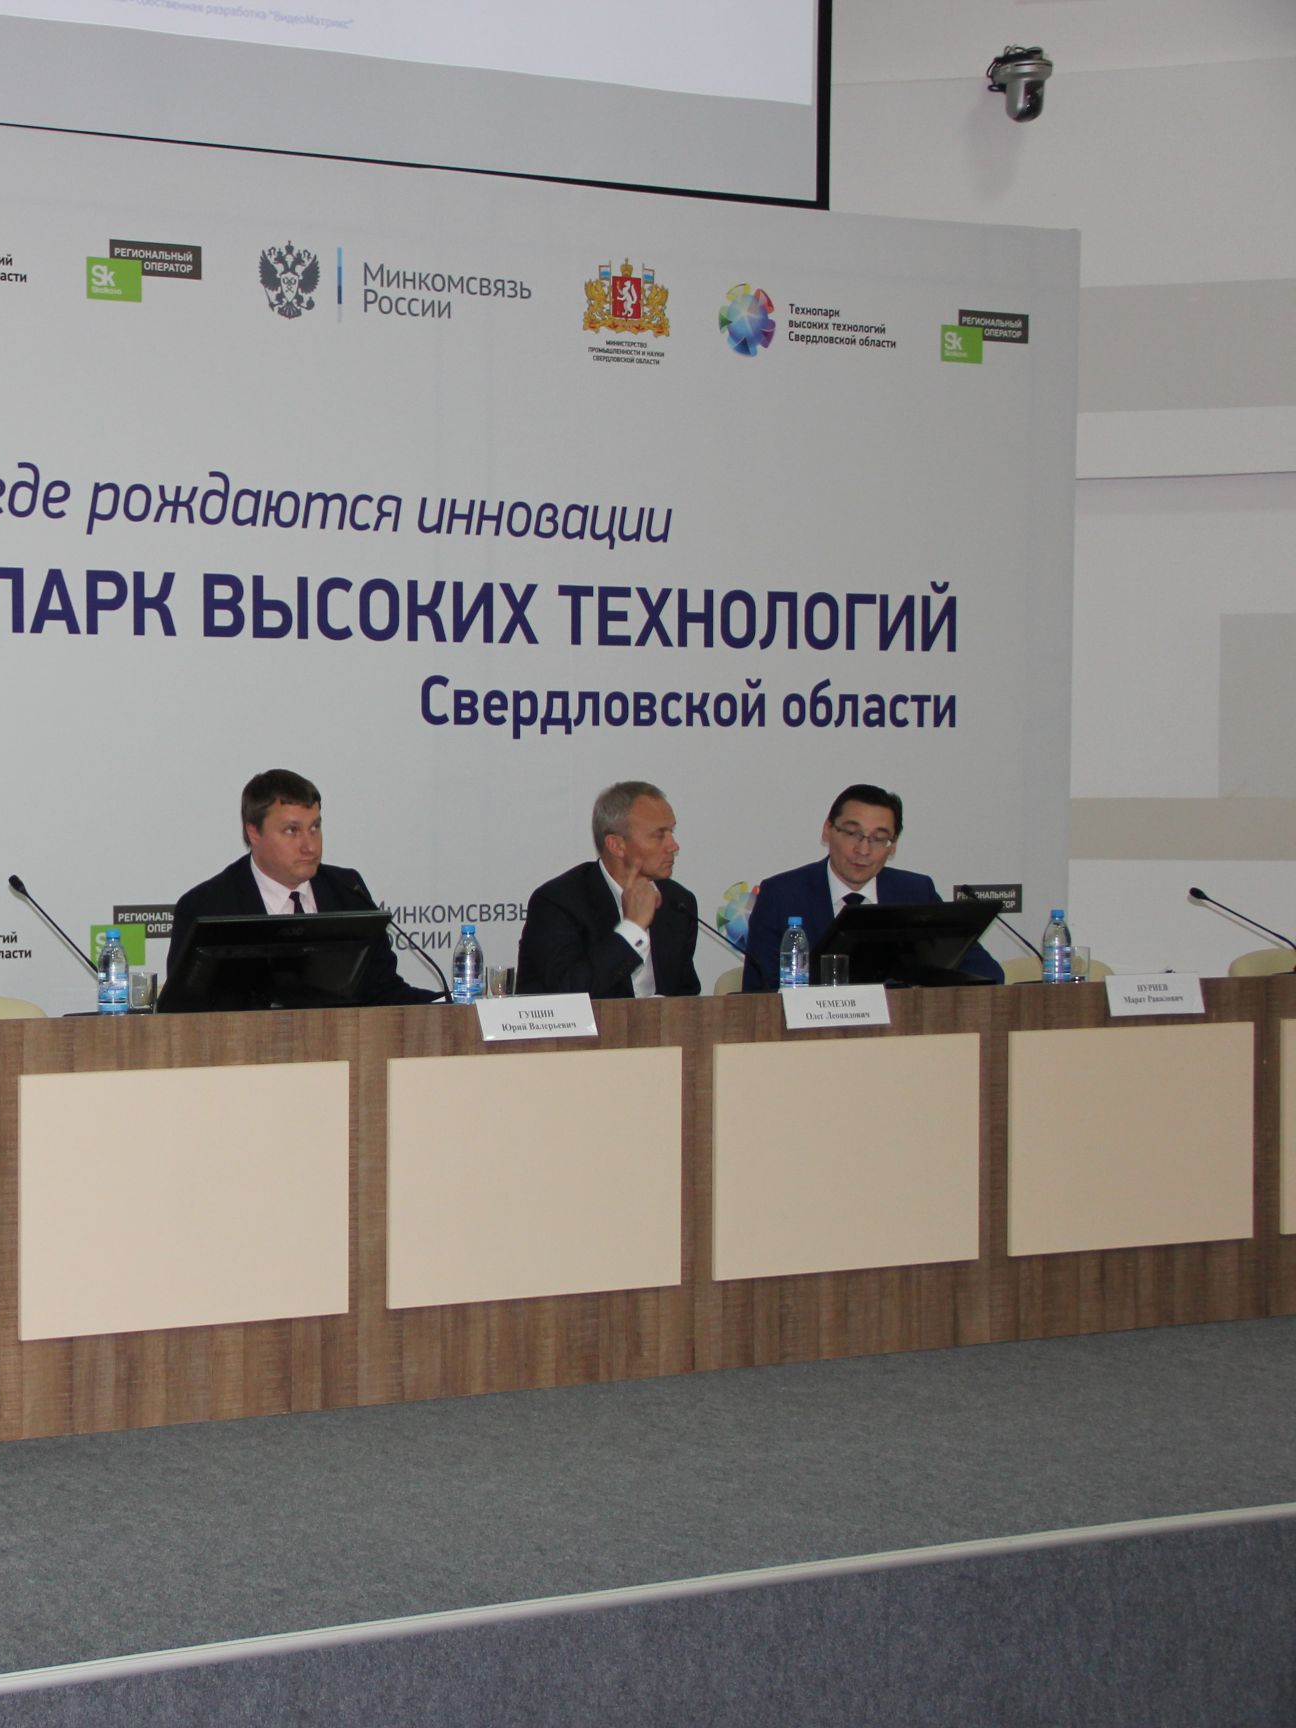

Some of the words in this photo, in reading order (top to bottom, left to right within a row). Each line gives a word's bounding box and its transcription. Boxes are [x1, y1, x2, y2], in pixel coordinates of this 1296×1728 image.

[206, 5, 267, 20] разработка
[114, 247, 193, 261] РЕГИОНАЛЬНЫЙ
[144, 261, 193, 273] ОПЕРАТОР
[91, 264, 116, 287] Sk
[788, 303, 841, 318] Технопарк
[788, 319, 829, 331] высоких
[832, 323, 886, 334] технологий
[961, 316, 1022, 328] РЕГИОНАЛЬНЫЙ
[788, 331, 856, 345] Свердловской
[859, 336, 896, 348] области
[984, 328, 1022, 338] ОПЕРАТОР
[944, 331, 963, 351] Sk
[87, 471, 400, 535] рождаются
[416, 497, 673, 548] инновации
[203, 573, 538, 645] ВЫСОКИХ
[558, 581, 957, 652] ТЕХНОЛОГИЙ
[420, 675, 766, 739] Свердловской
[782, 679, 957, 729] области
[117, 912, 175, 922] РЕГИОНАЛЬ
[815, 999, 857, 1009] ЧЕМЕЗОВ
[1123, 995, 1146, 1005] Марат
[518, 1009, 555, 1020] ГУЩИН
[805, 1012, 824, 1021] Олег
[825, 1011, 871, 1020] Леонидович
[501, 1022, 528, 1033] Юрий
[529, 1021, 577, 1032] Валерьевич
